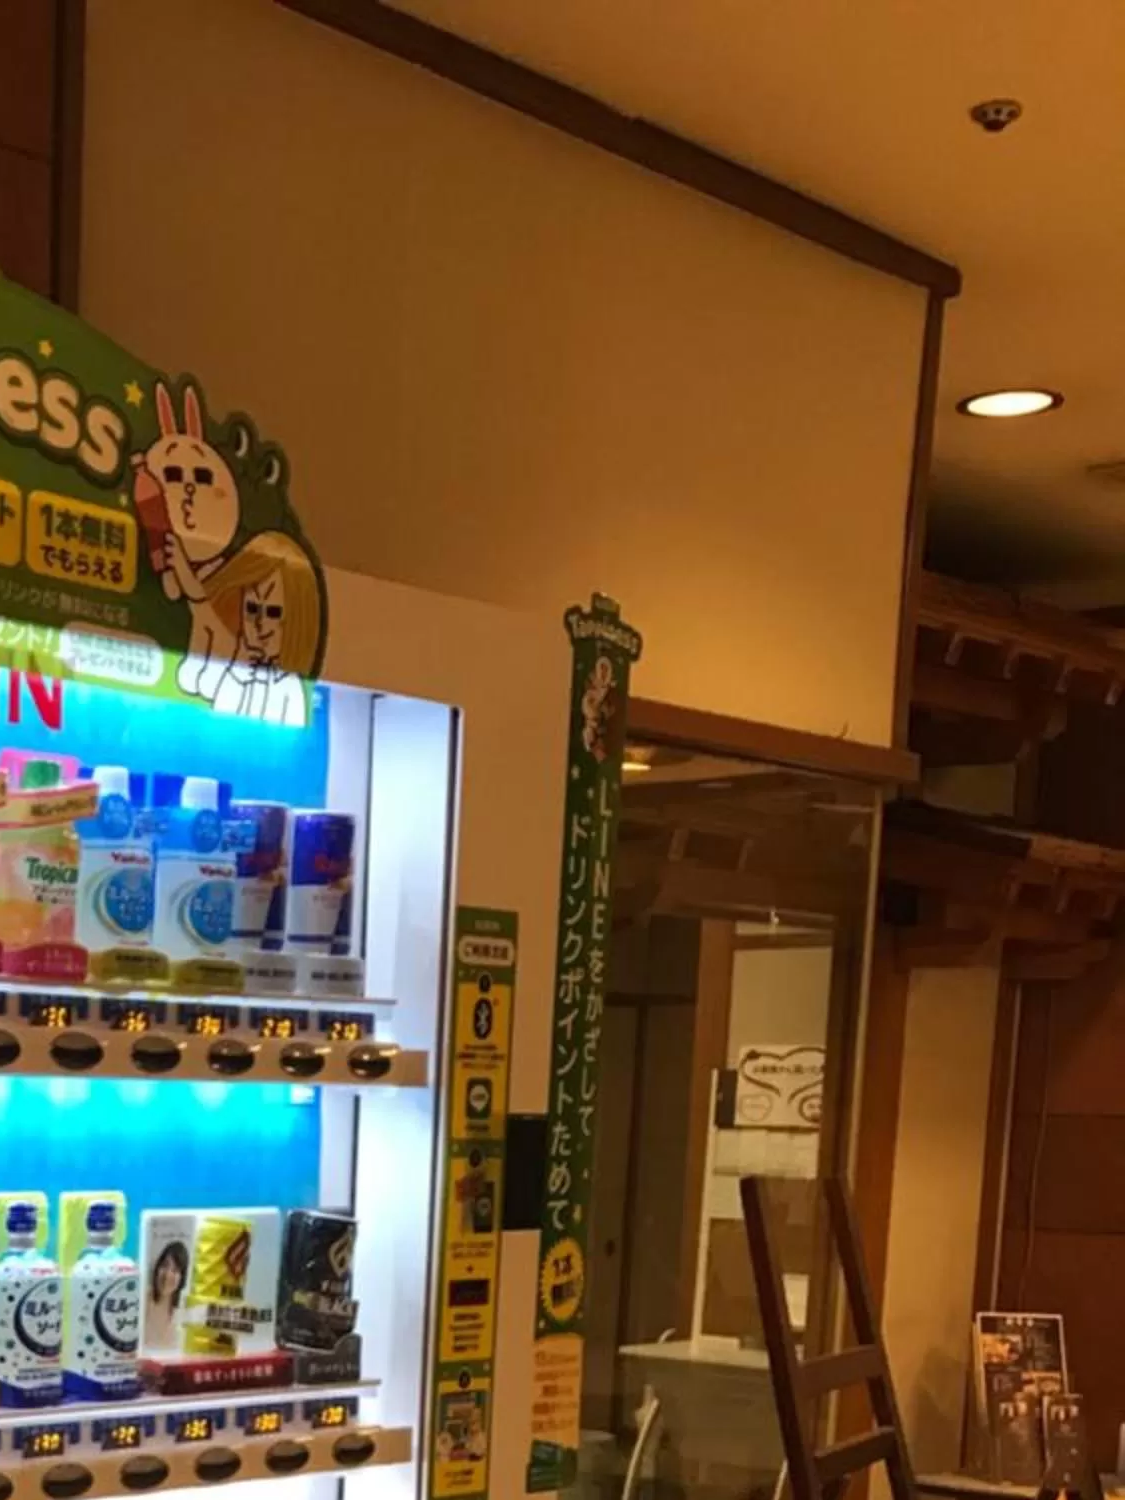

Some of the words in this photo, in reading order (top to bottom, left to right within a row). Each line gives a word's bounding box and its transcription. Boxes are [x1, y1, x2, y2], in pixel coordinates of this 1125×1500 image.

[39, 501, 129, 555] 1本無料
[39, 544, 125, 584] でもらえる
